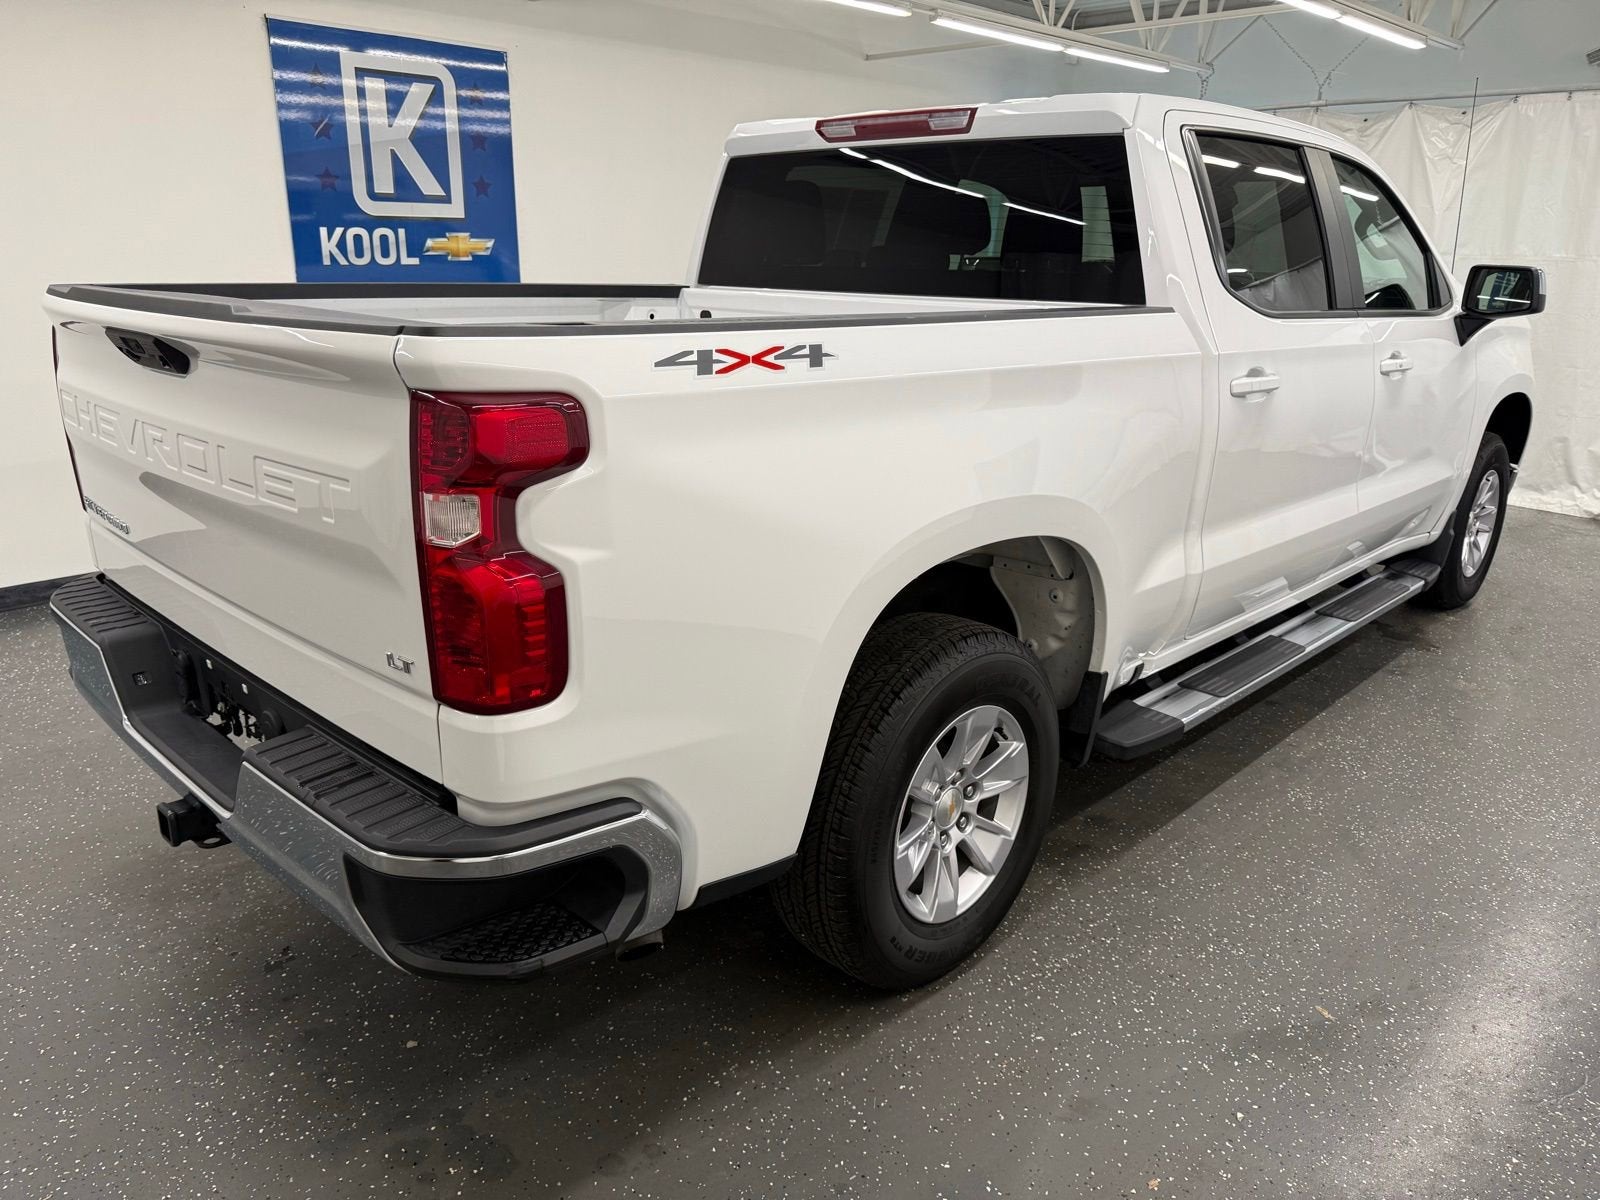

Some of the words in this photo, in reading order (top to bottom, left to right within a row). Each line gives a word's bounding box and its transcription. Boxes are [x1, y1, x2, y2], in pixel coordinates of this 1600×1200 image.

[364, 76, 447, 196] K
[319, 226, 420, 266] KOOL
[59, 388, 351, 524] CHEVROLET
[386, 651, 415, 674] LT
